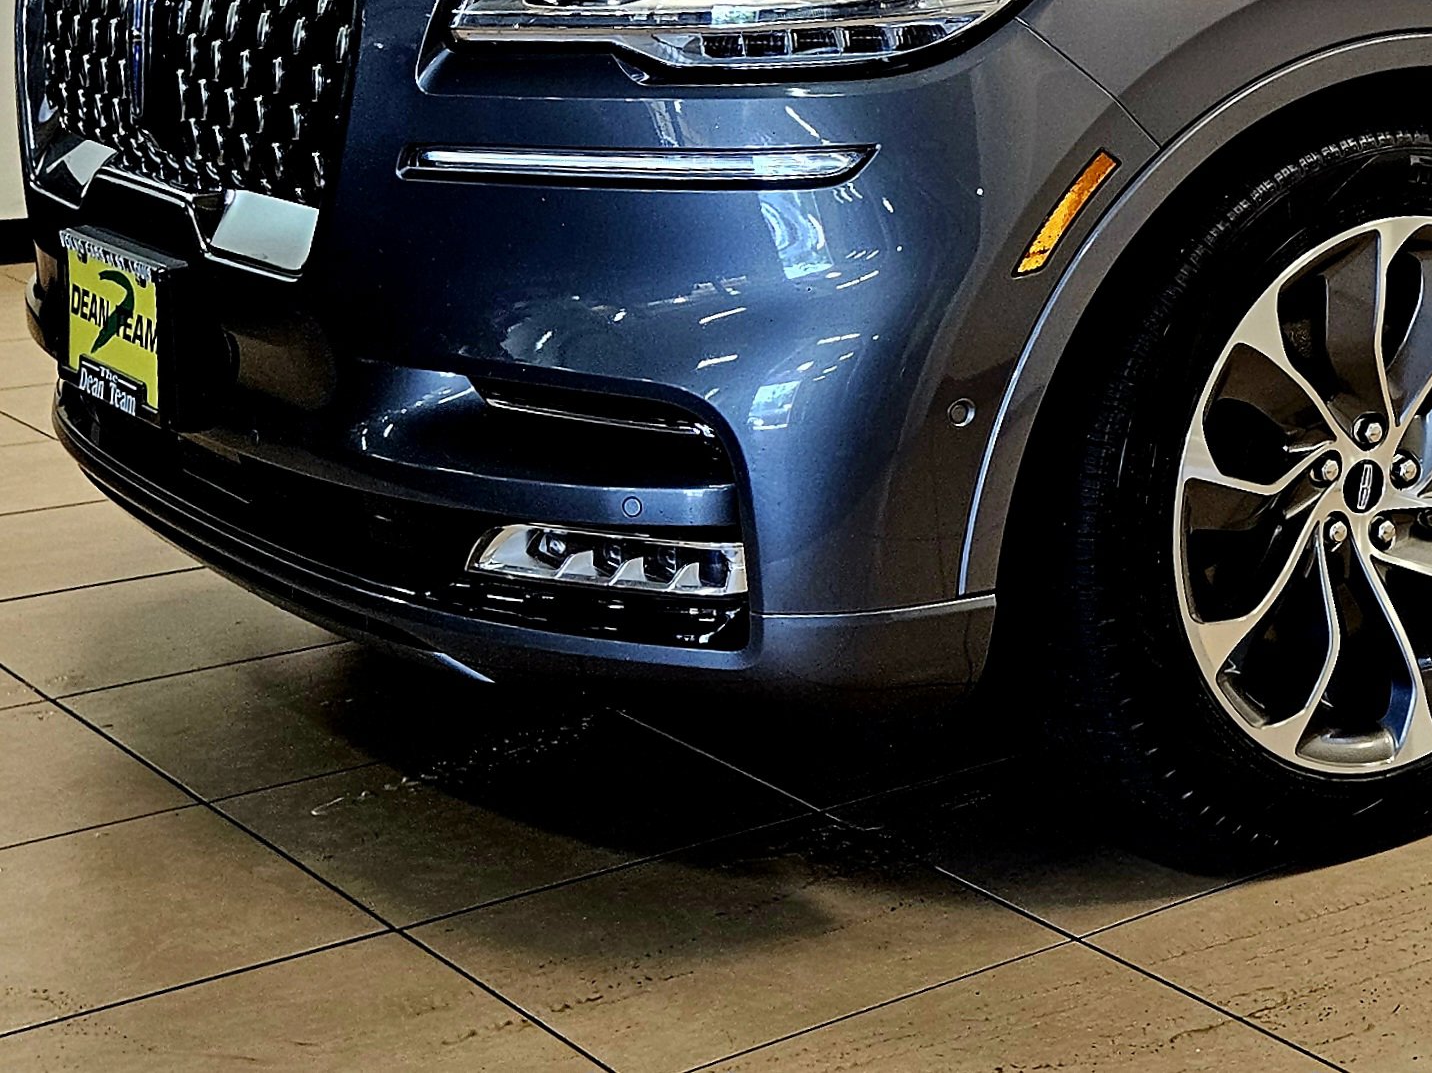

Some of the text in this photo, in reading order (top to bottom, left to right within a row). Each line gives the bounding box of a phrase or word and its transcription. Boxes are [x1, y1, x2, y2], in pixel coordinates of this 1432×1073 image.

[71, 283, 109, 329] DEAN
[78, 367, 136, 417] Dean Team
[99, 366, 118, 383] The
